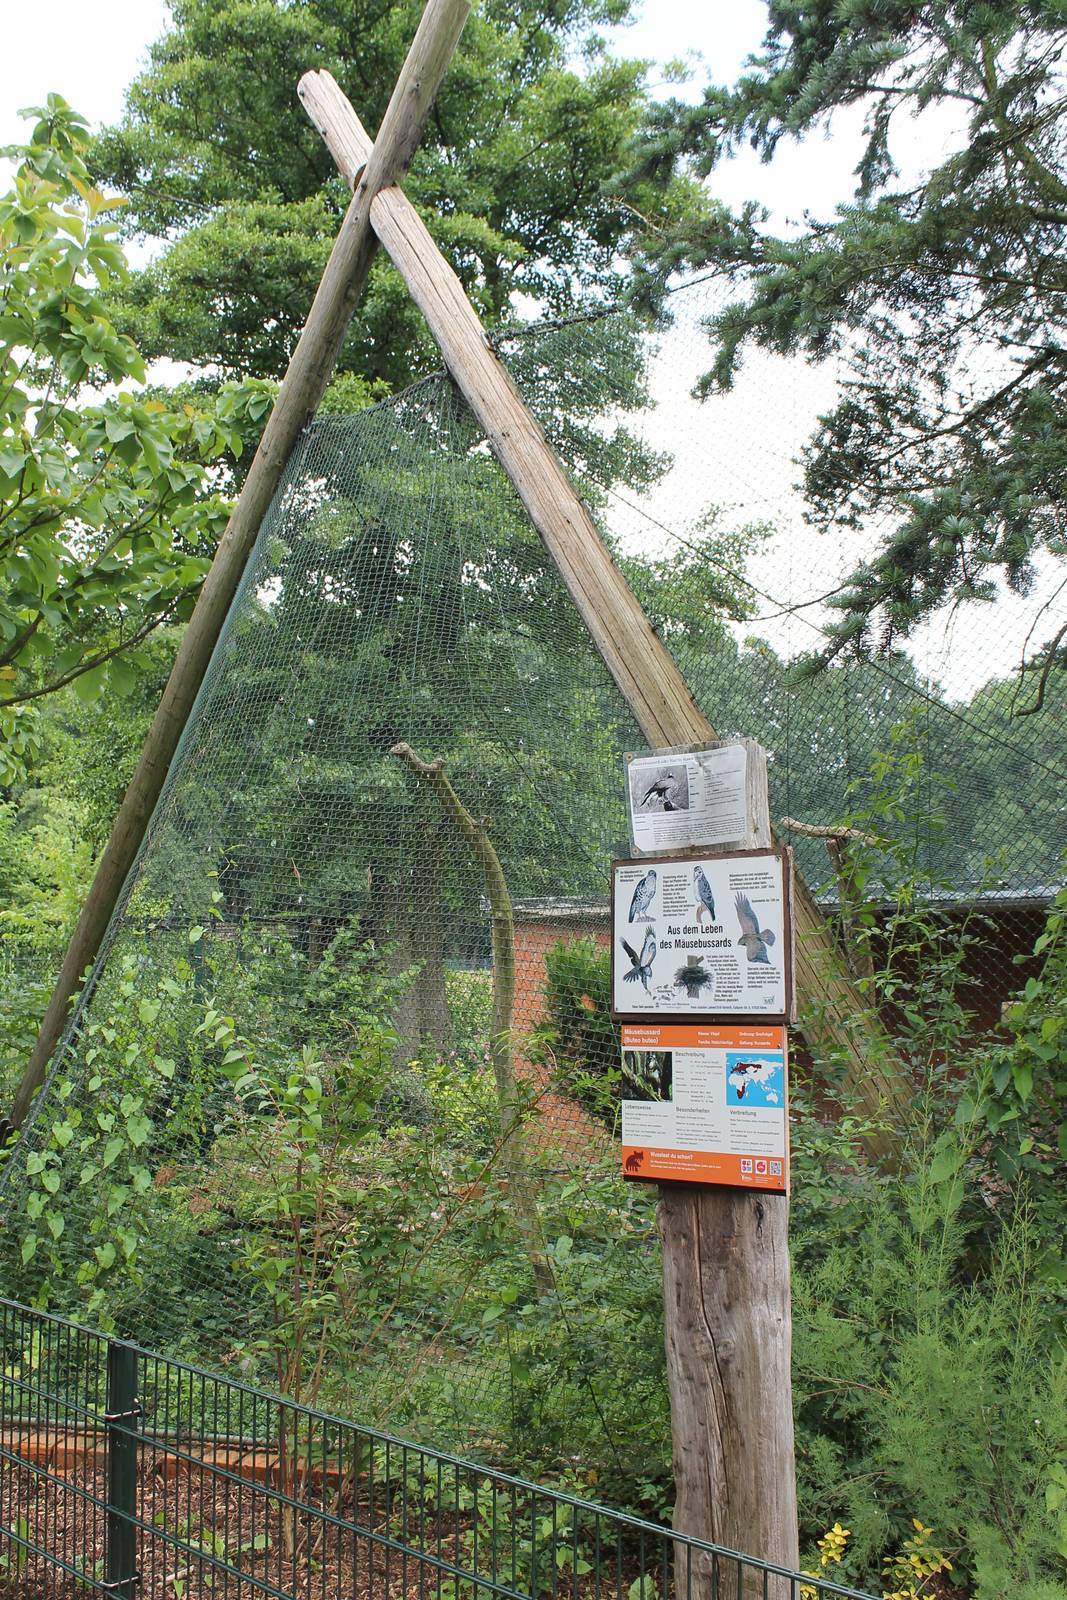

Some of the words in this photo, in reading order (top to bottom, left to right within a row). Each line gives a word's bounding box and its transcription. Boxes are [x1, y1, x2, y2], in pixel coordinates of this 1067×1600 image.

[667, 925, 681, 935] Aus
[682, 925, 699, 935] dem
[700, 924, 724, 934] Leben
[659, 939, 673, 949] des
[674, 937, 732, 949] Mäusebussards
